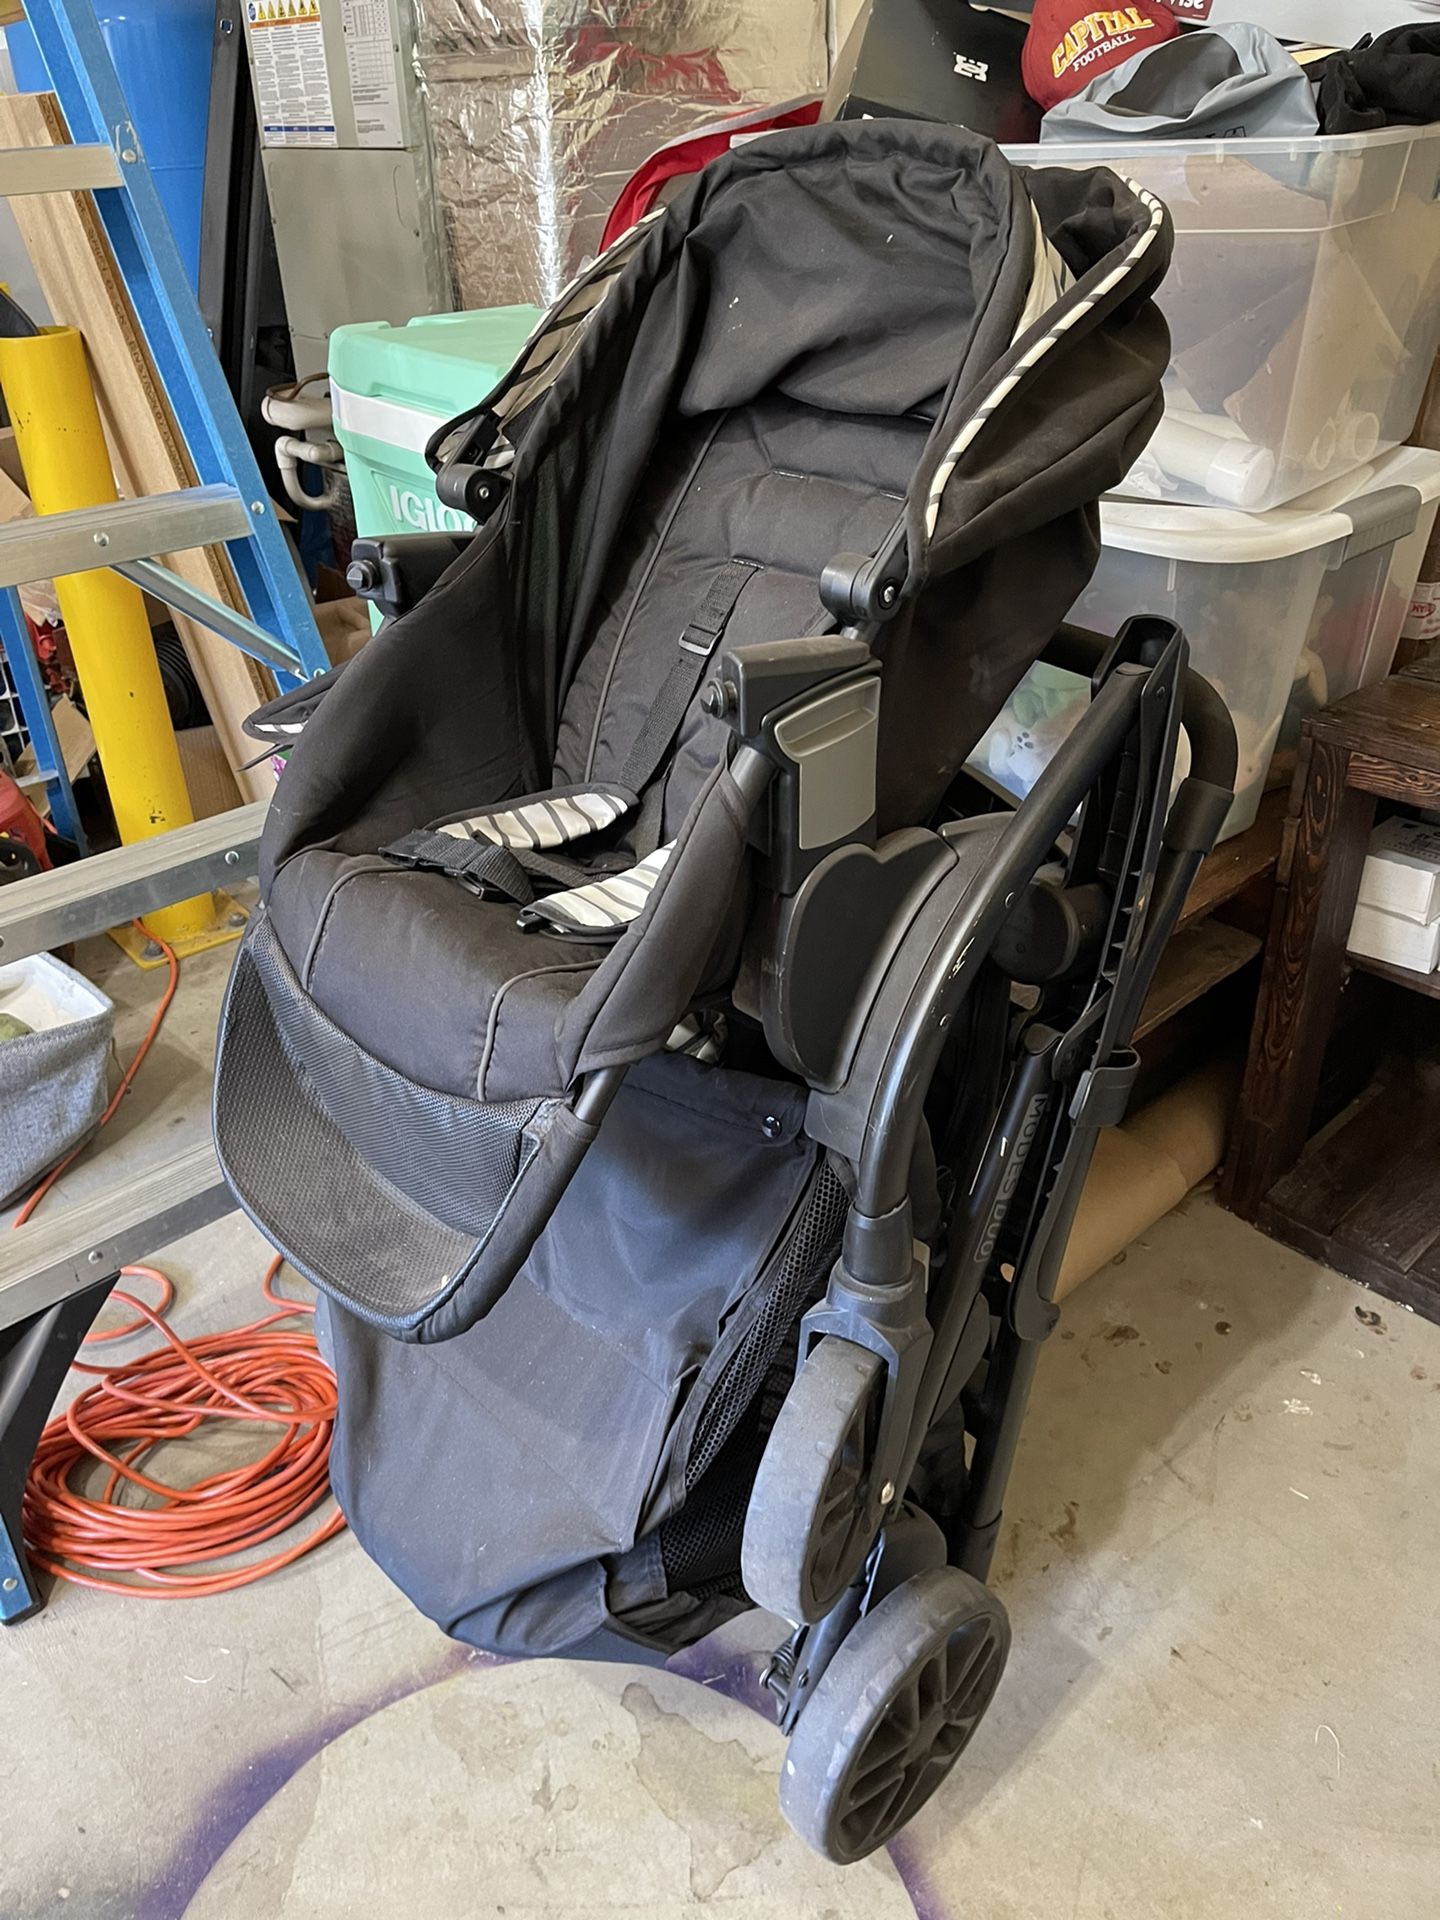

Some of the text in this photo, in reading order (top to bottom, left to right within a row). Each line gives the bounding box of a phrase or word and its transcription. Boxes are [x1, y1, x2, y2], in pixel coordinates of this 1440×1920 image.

[1052, 7, 1154, 78] CAPITAL
[1072, 33, 1136, 72] FOOTBALL
[389, 485, 478, 532] IGLO
[980, 1093, 1048, 1257] MODES DUO
